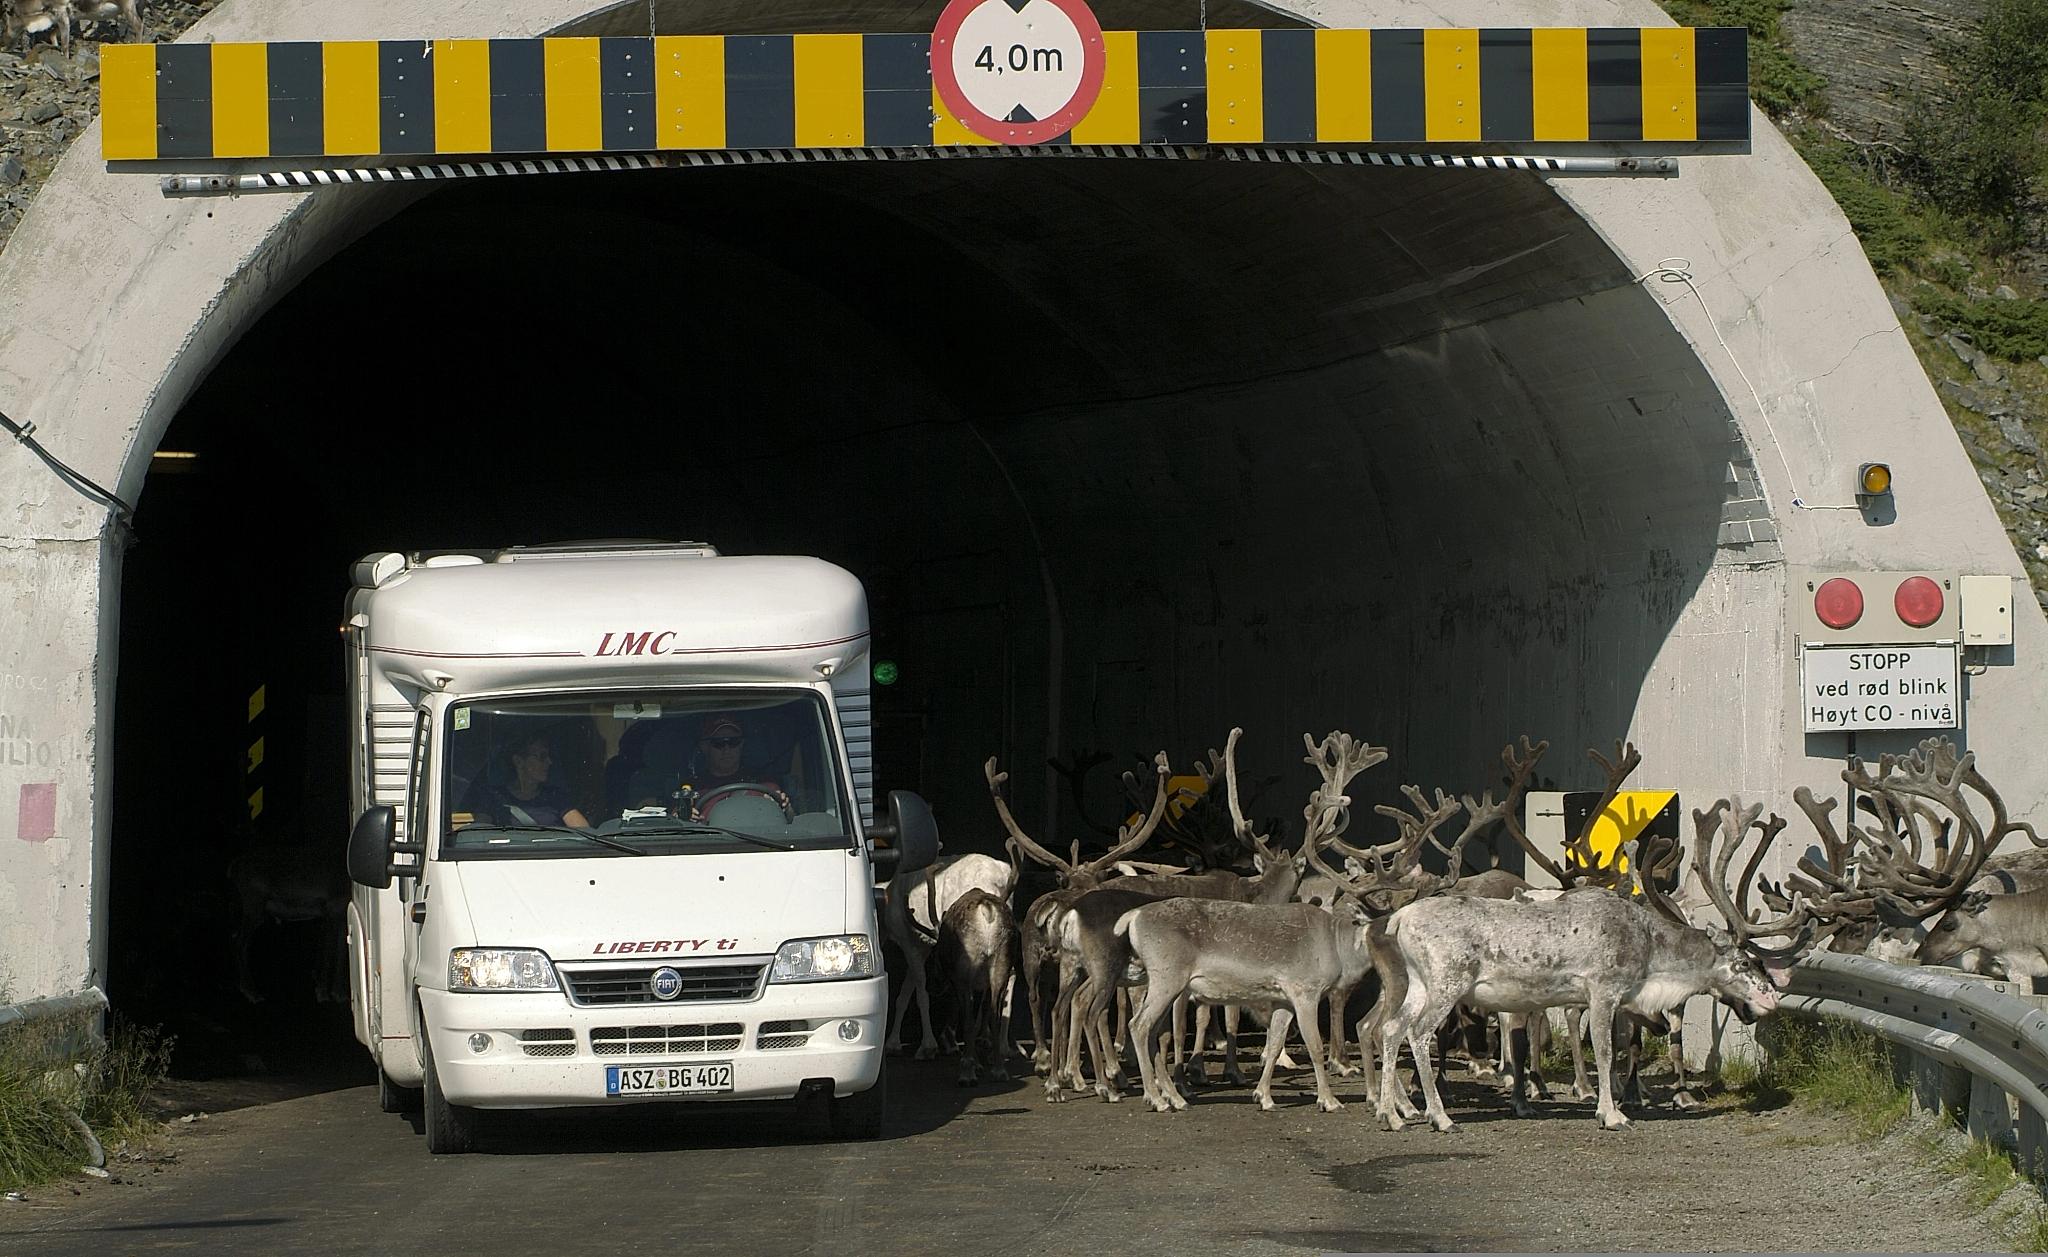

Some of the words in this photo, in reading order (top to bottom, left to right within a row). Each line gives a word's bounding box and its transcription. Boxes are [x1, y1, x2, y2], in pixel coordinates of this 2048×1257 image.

[974, 44, 1063, 76] 4,0m
[594, 630, 678, 657] LMC
[1849, 653, 1911, 670] STOPP
[1816, 680, 1849, 697] ved
[1858, 679, 1889, 696] rød
[1899, 678, 1948, 694] blink
[1811, 706, 1858, 726] Høyt
[1864, 705, 1892, 722] CO
[1911, 703, 1952, 721] nivå
[592, 939, 710, 955] LIBERTY
[716, 938, 739, 950] ti
[657, 978, 676, 989] FIAT
[620, 1070, 655, 1090] ASZ
[668, 1068, 692, 1088] BG
[696, 1067, 730, 1087] 402
